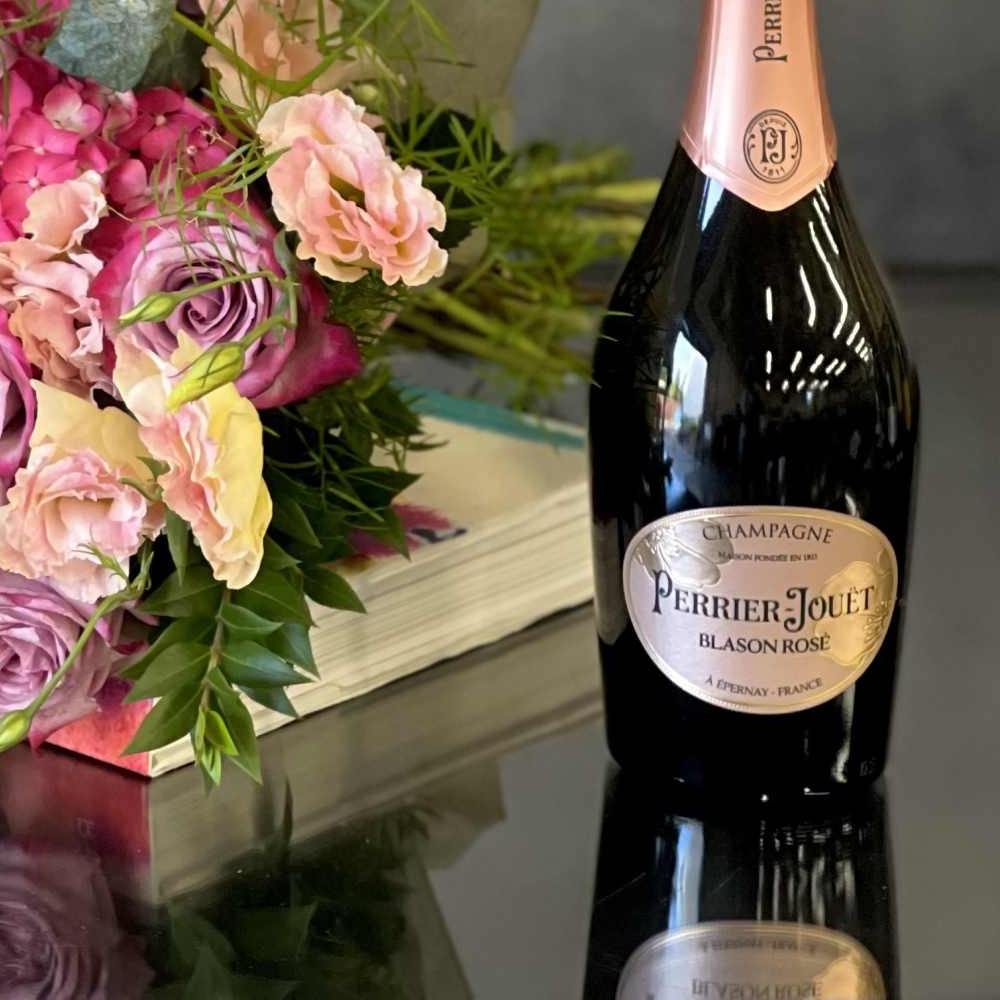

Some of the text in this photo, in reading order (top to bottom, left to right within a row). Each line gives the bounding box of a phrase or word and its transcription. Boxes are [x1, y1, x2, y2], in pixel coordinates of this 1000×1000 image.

[702, 523, 834, 544] CHAMPAGNE
[699, 632, 831, 654] BLASON ROSÉ
[717, 677, 769, 697] ÉPERNAY
[778, 677, 822, 697] FRANCE
